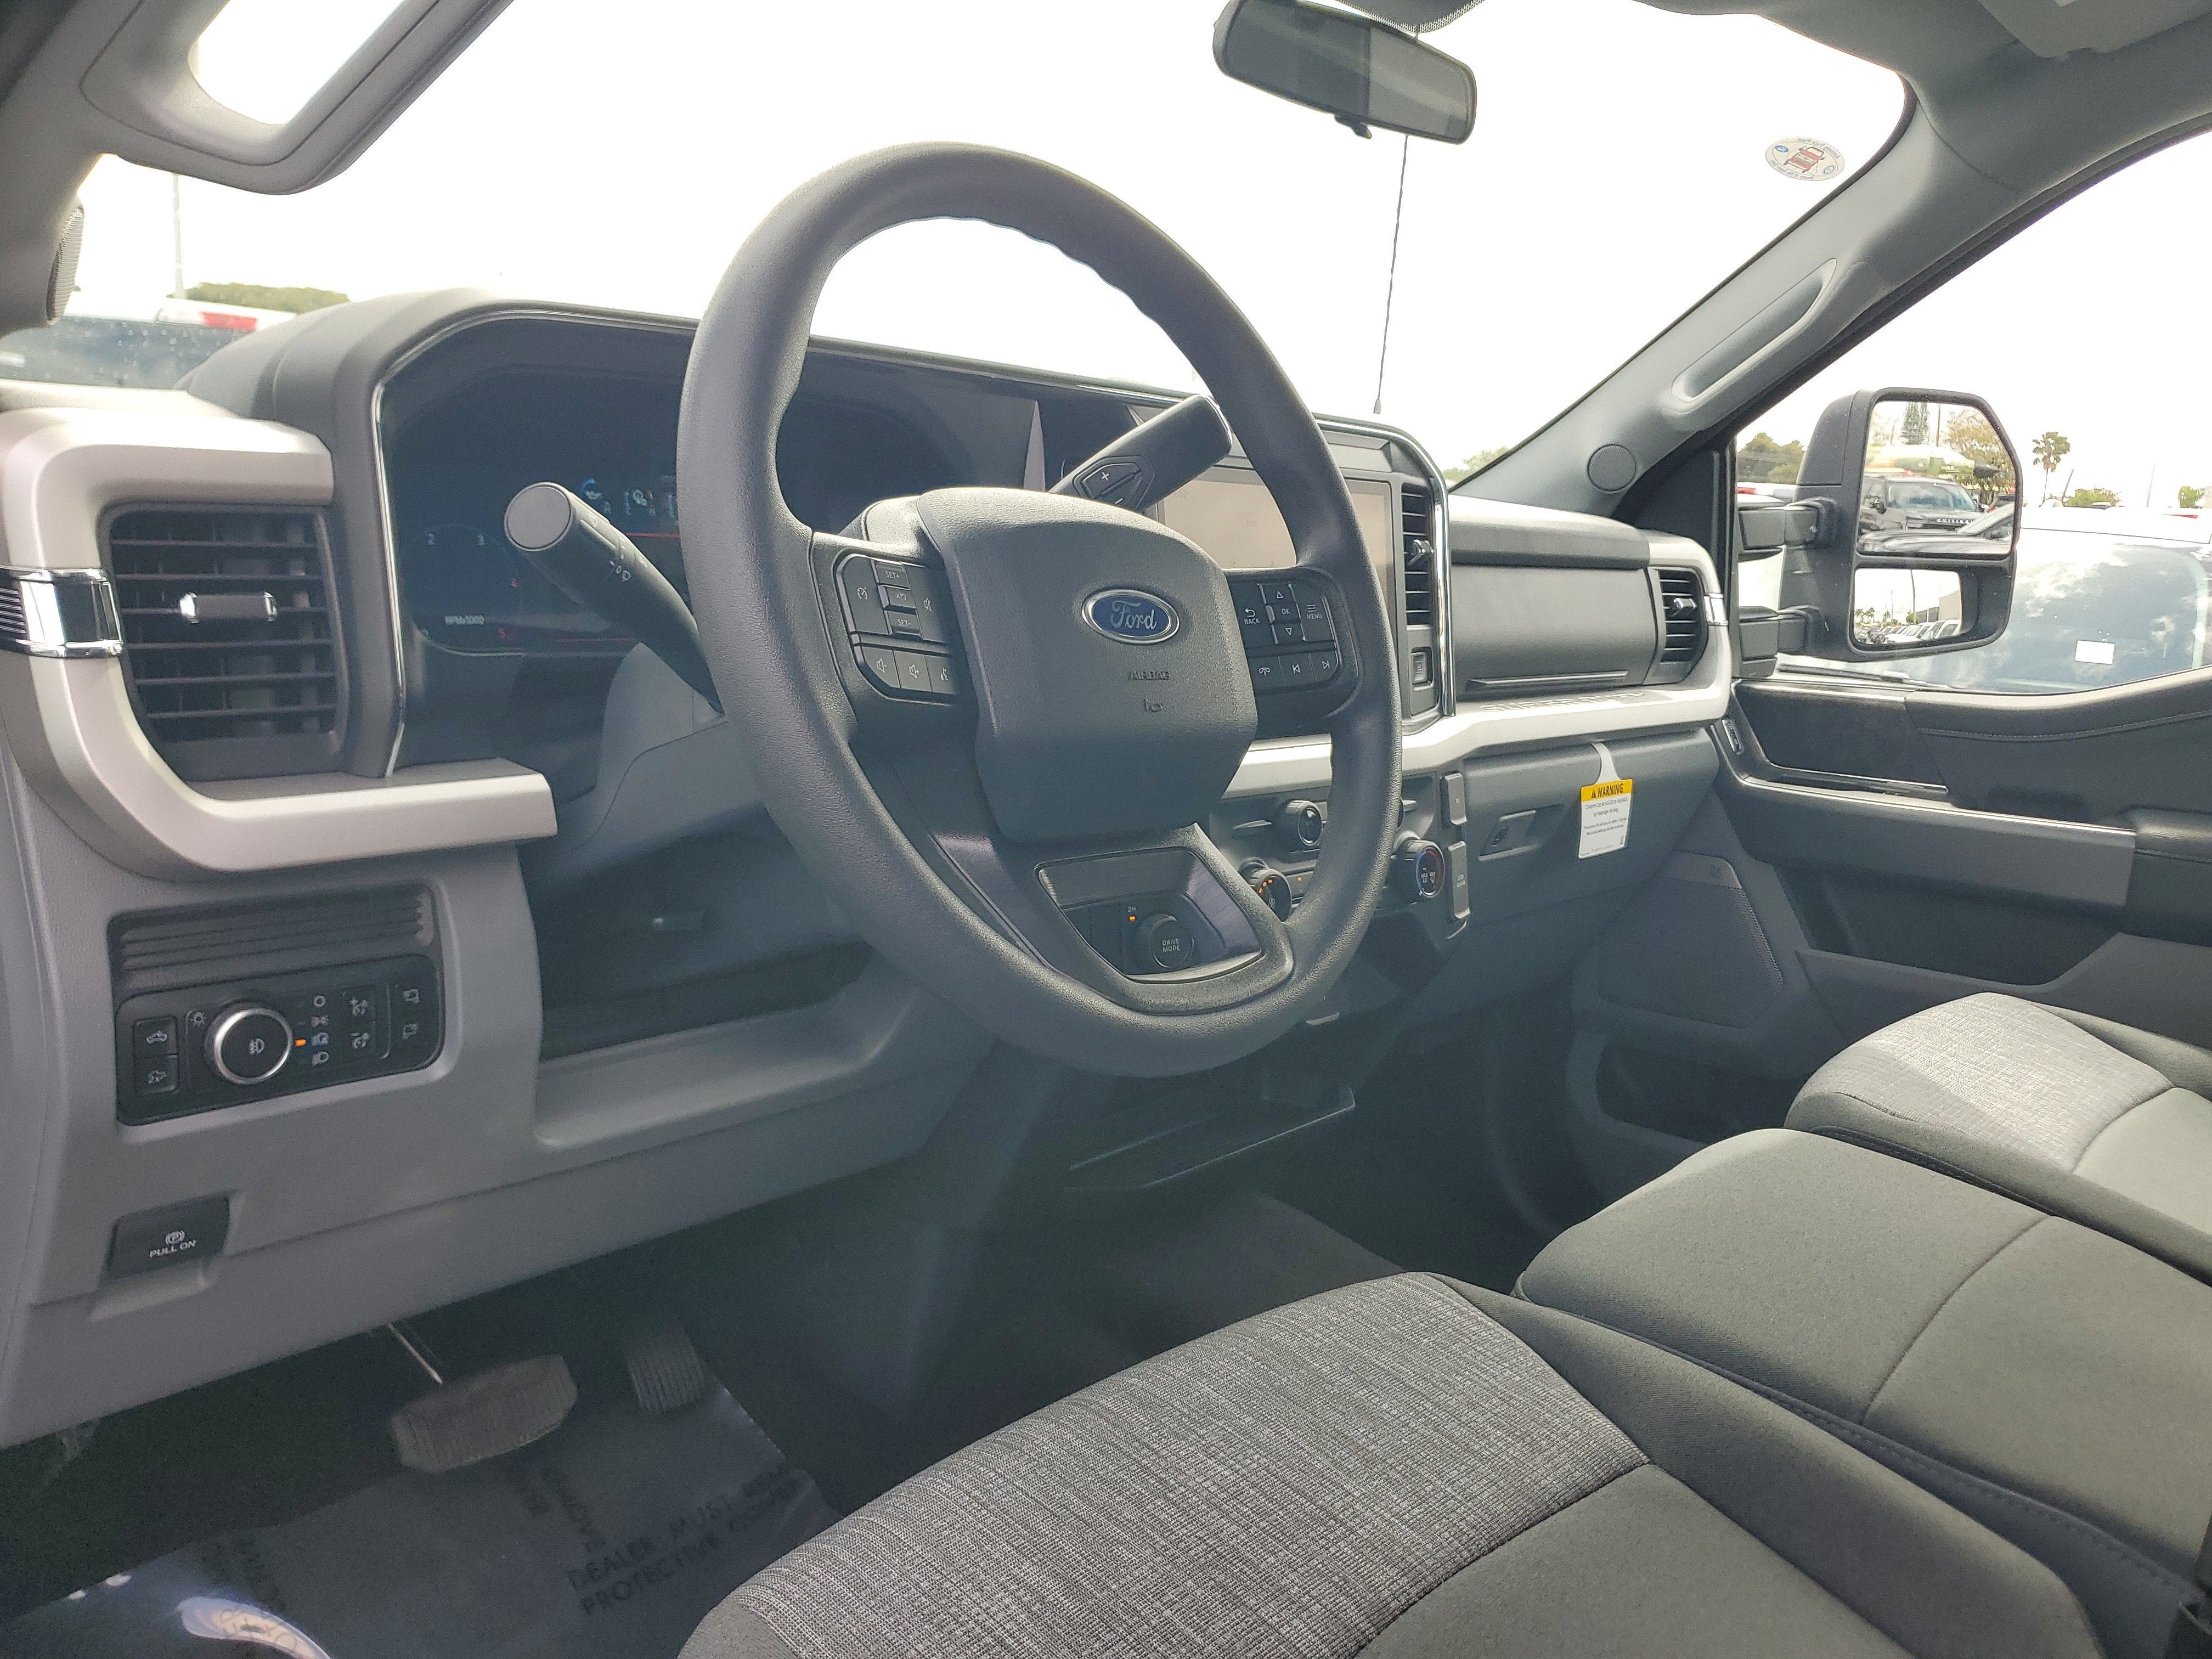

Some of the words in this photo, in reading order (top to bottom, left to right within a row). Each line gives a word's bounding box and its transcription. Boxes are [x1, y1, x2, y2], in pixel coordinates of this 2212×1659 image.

[1110, 600, 1157, 630] Ford
[1597, 783, 1623, 798] WARNING
[149, 1245, 177, 1258] PULL
[179, 1239, 196, 1250] ON
[567, 1534, 657, 1592] DEALER
[667, 1493, 733, 1541] MUST
